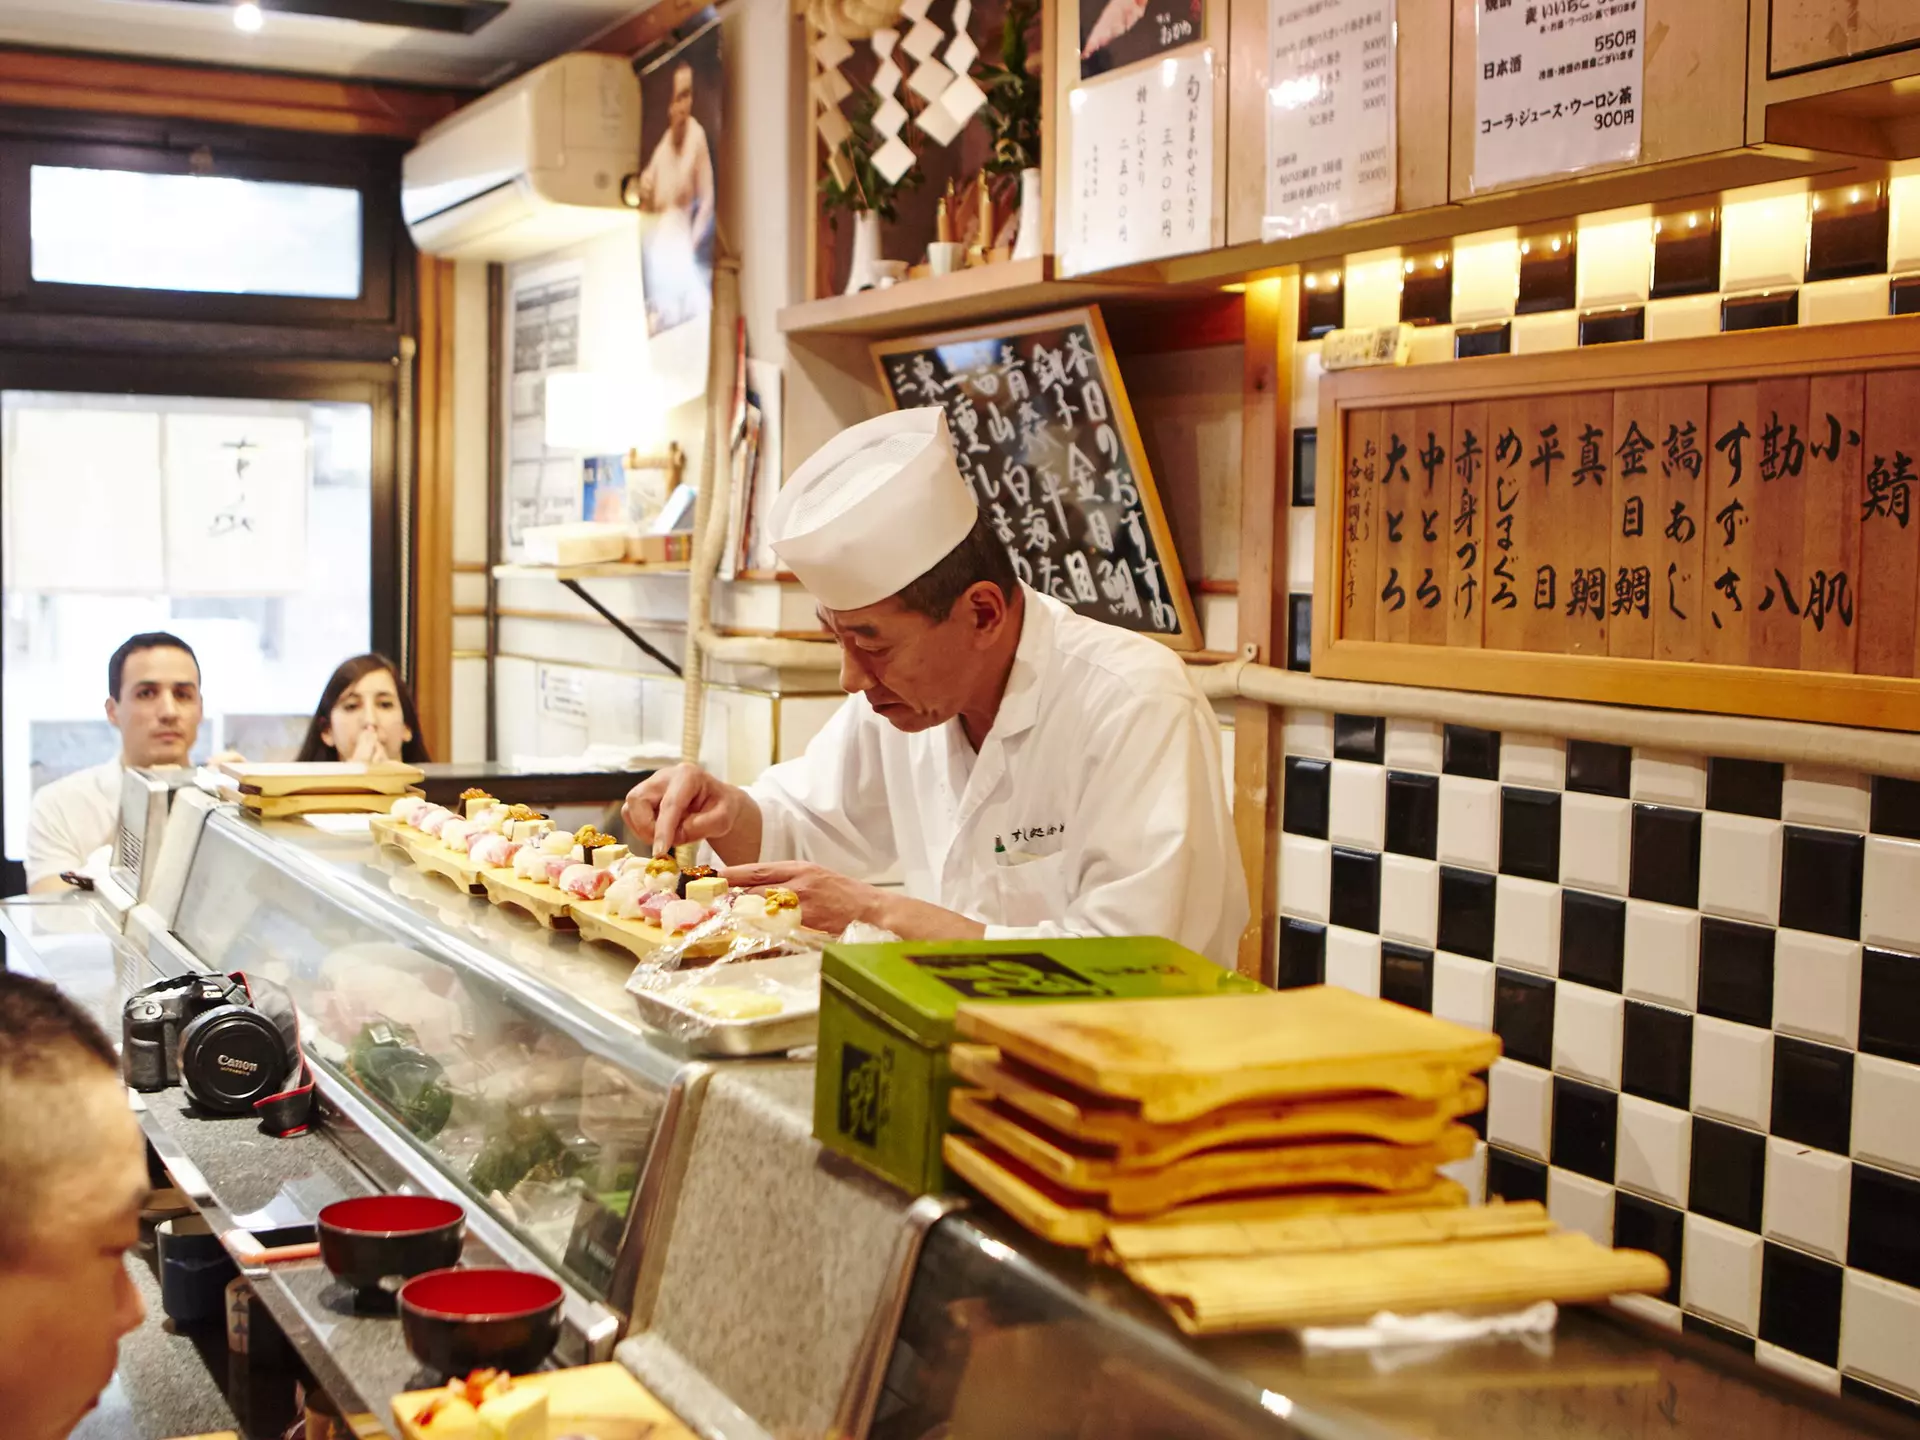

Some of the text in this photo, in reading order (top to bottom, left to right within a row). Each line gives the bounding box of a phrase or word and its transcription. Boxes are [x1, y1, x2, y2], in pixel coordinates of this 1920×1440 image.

[1481, 86, 1633, 134] コーラ・ジュース・ウーロン茶
[1484, 54, 1523, 80] 日本酒
[1594, 109, 1635, 131] 300円
[1595, 29, 1637, 52] 550円
[1066, 332, 1176, 631] 本日のおすすめ
[1381, 433, 1411, 613] 大とろ
[1416, 431, 1446, 610] 中とろ
[1454, 429, 1483, 620] 赤身づけ
[1491, 427, 1523, 610] めじまぐろ
[1530, 424, 1565, 610] 平目
[1566, 423, 1607, 622] 真鯛
[1611, 420, 1655, 620] 金目鯛
[1661, 420, 1703, 621] 縞あじ
[1711, 420, 1752, 629] すずき
[1803, 412, 1861, 633] 小肌
[1860, 450, 1919, 529] 鯖
[217, 1054, 258, 1072] Canon
